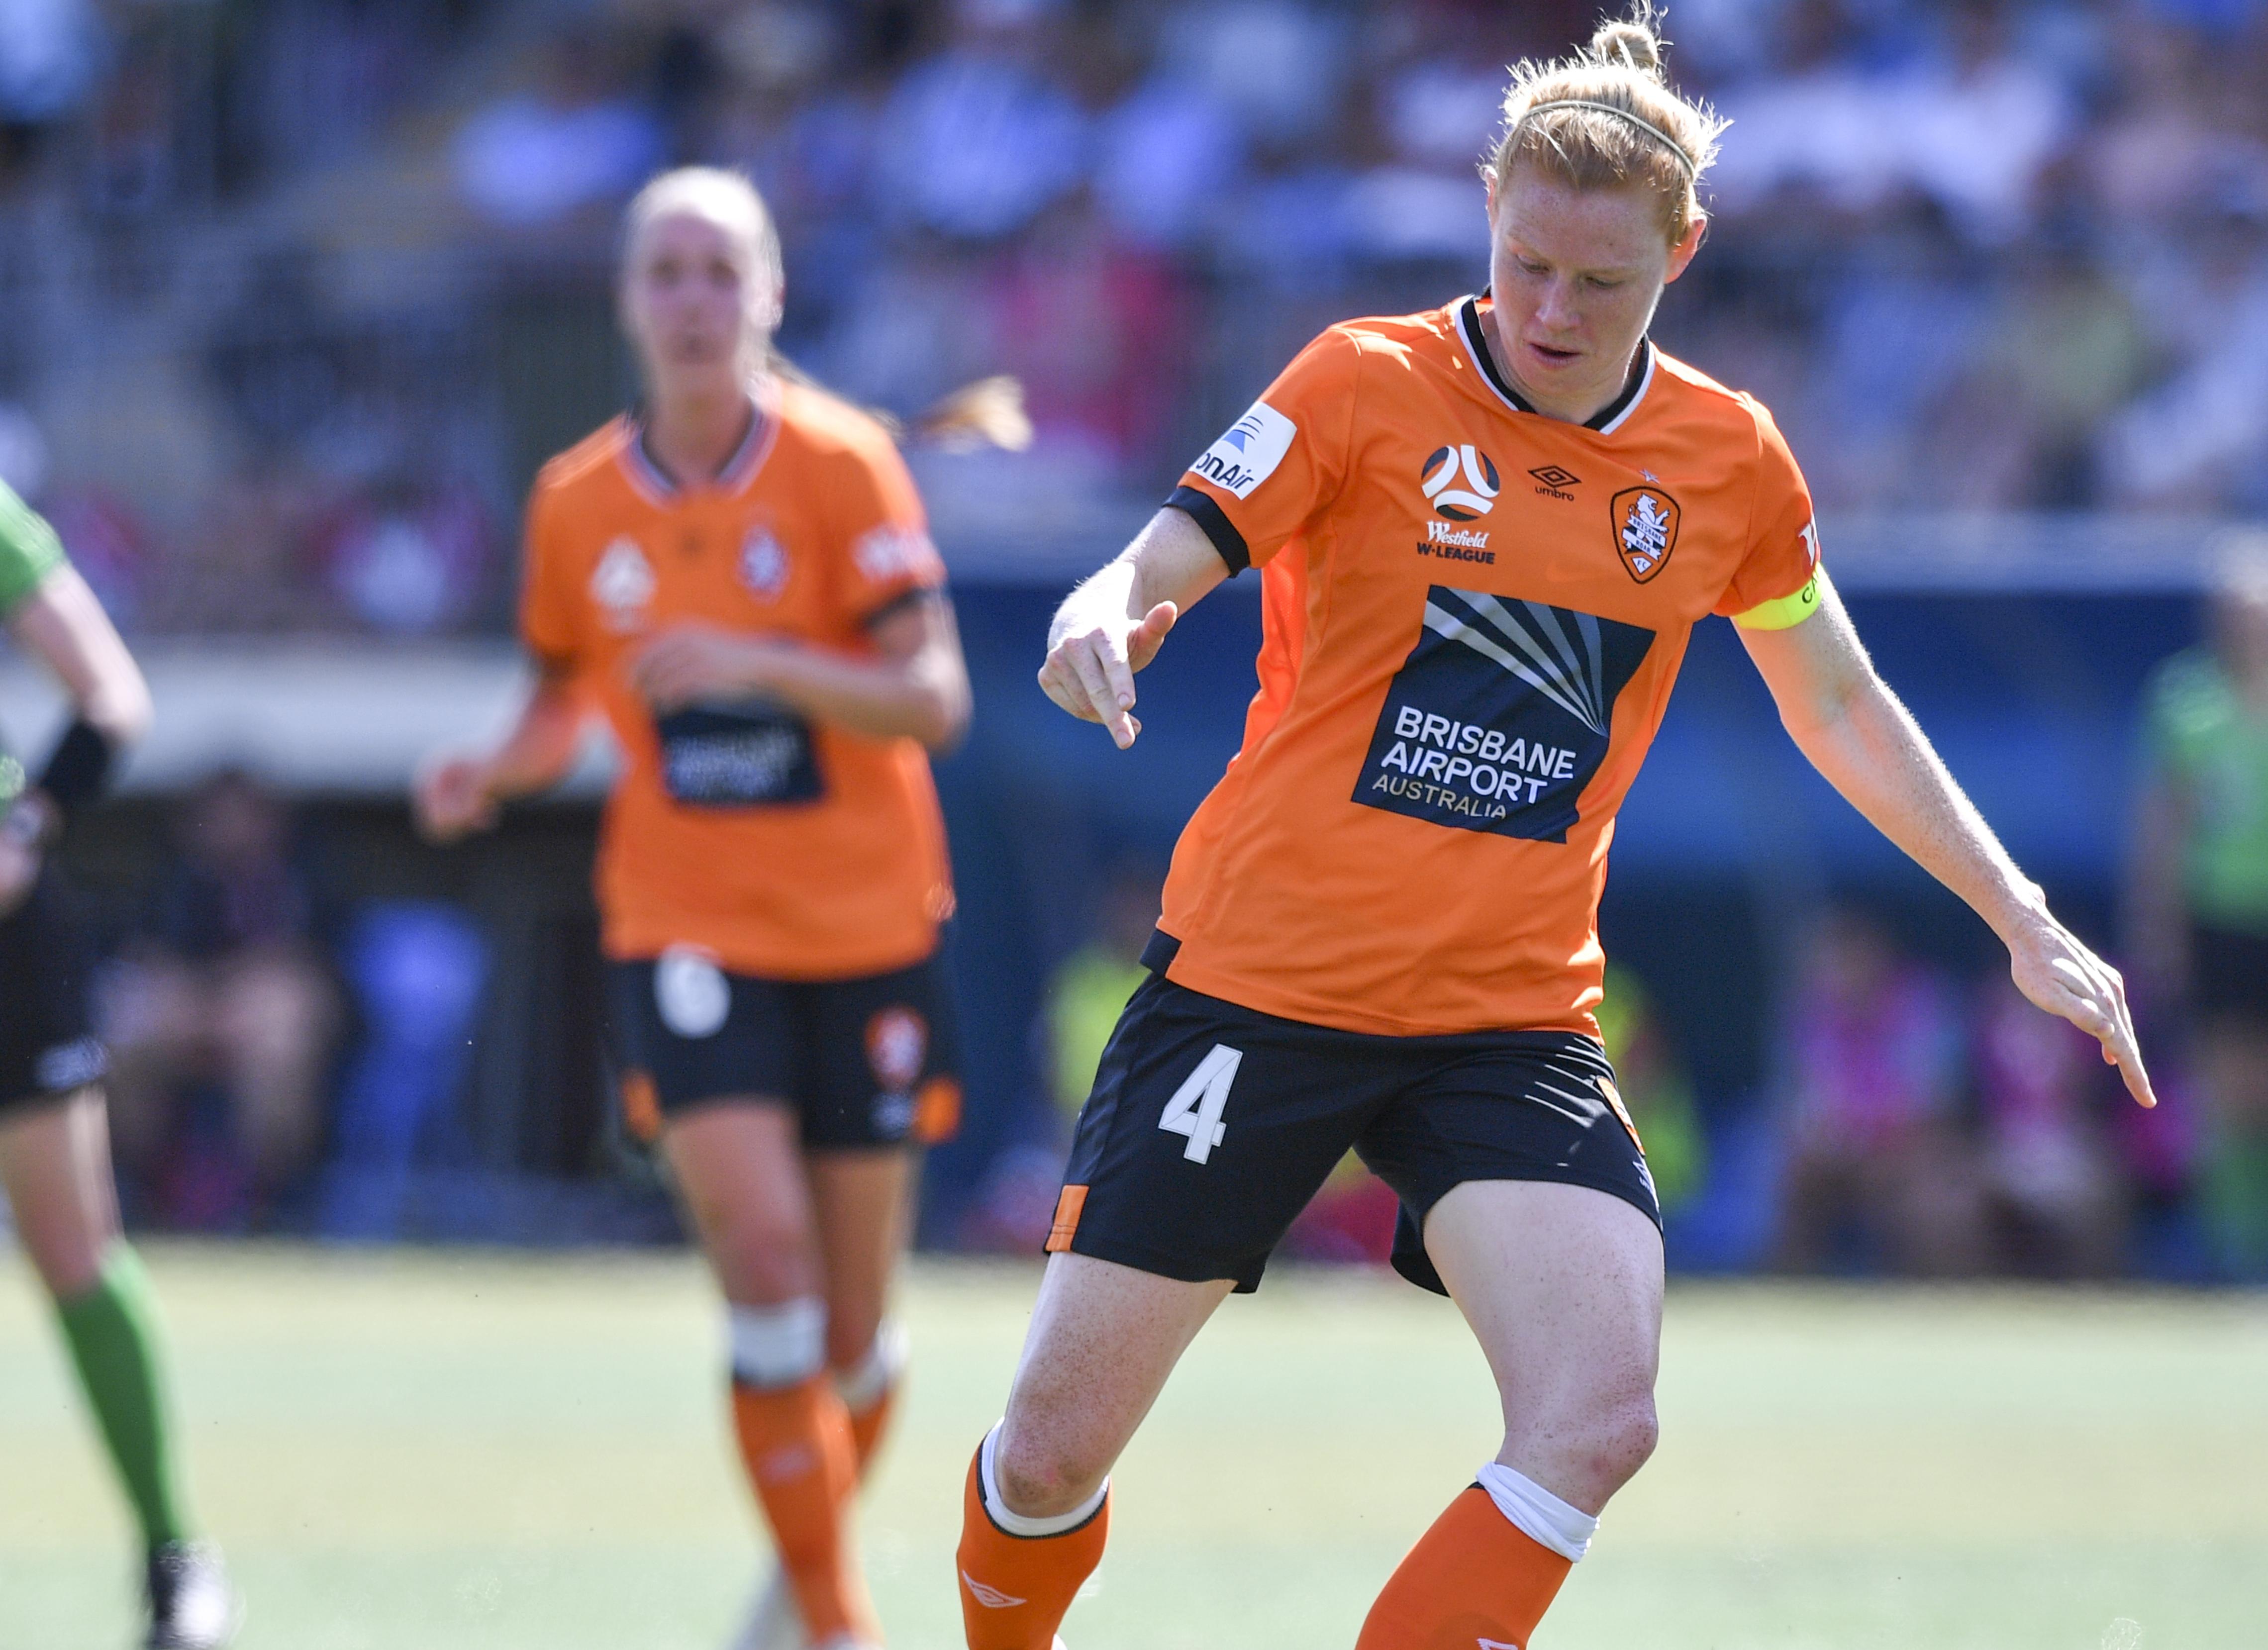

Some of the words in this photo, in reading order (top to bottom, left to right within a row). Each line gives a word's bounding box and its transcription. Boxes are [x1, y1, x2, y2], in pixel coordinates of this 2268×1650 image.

[1535, 485, 1575, 501] umbro
[1425, 520, 1489, 548] Westfield
[1634, 519, 1662, 542] BRISBANE
[1636, 540, 1651, 553] ROAR
[1638, 560, 1647, 568] FC
[1394, 705, 1577, 779] BRISBANE
[1381, 741, 1548, 804] AIRPORT
[1372, 774, 1507, 820] AUSTRALIA
[1158, 1043, 1243, 1165] 4
